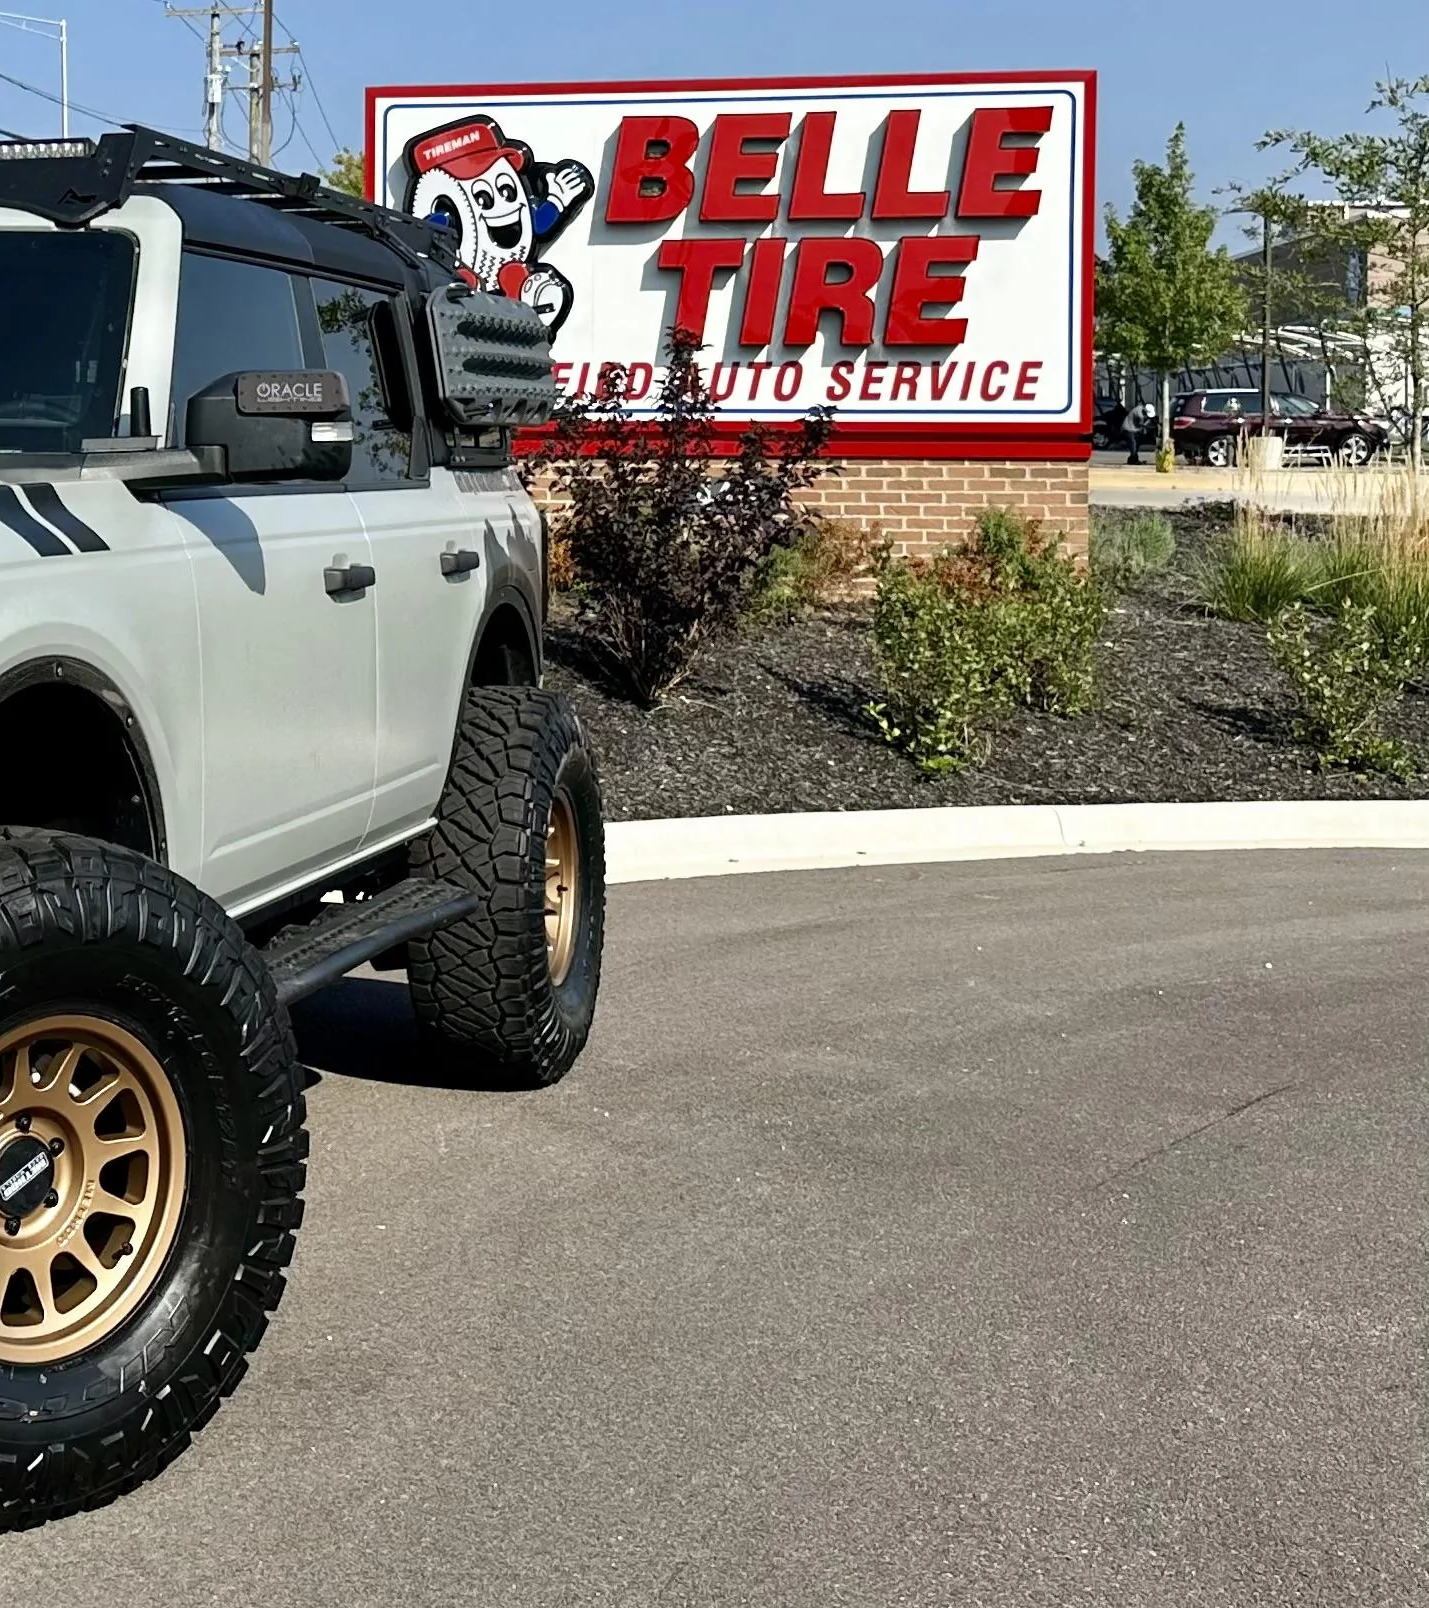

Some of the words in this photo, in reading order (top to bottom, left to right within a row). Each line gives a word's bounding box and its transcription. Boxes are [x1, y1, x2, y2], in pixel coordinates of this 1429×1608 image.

[422, 130, 481, 160] TIREMAN
[605, 106, 1054, 224] BELLE
[658, 235, 981, 347] TIRE
[256, 382, 323, 398] ORACLE
[825, 360, 1044, 402] SERVICE
